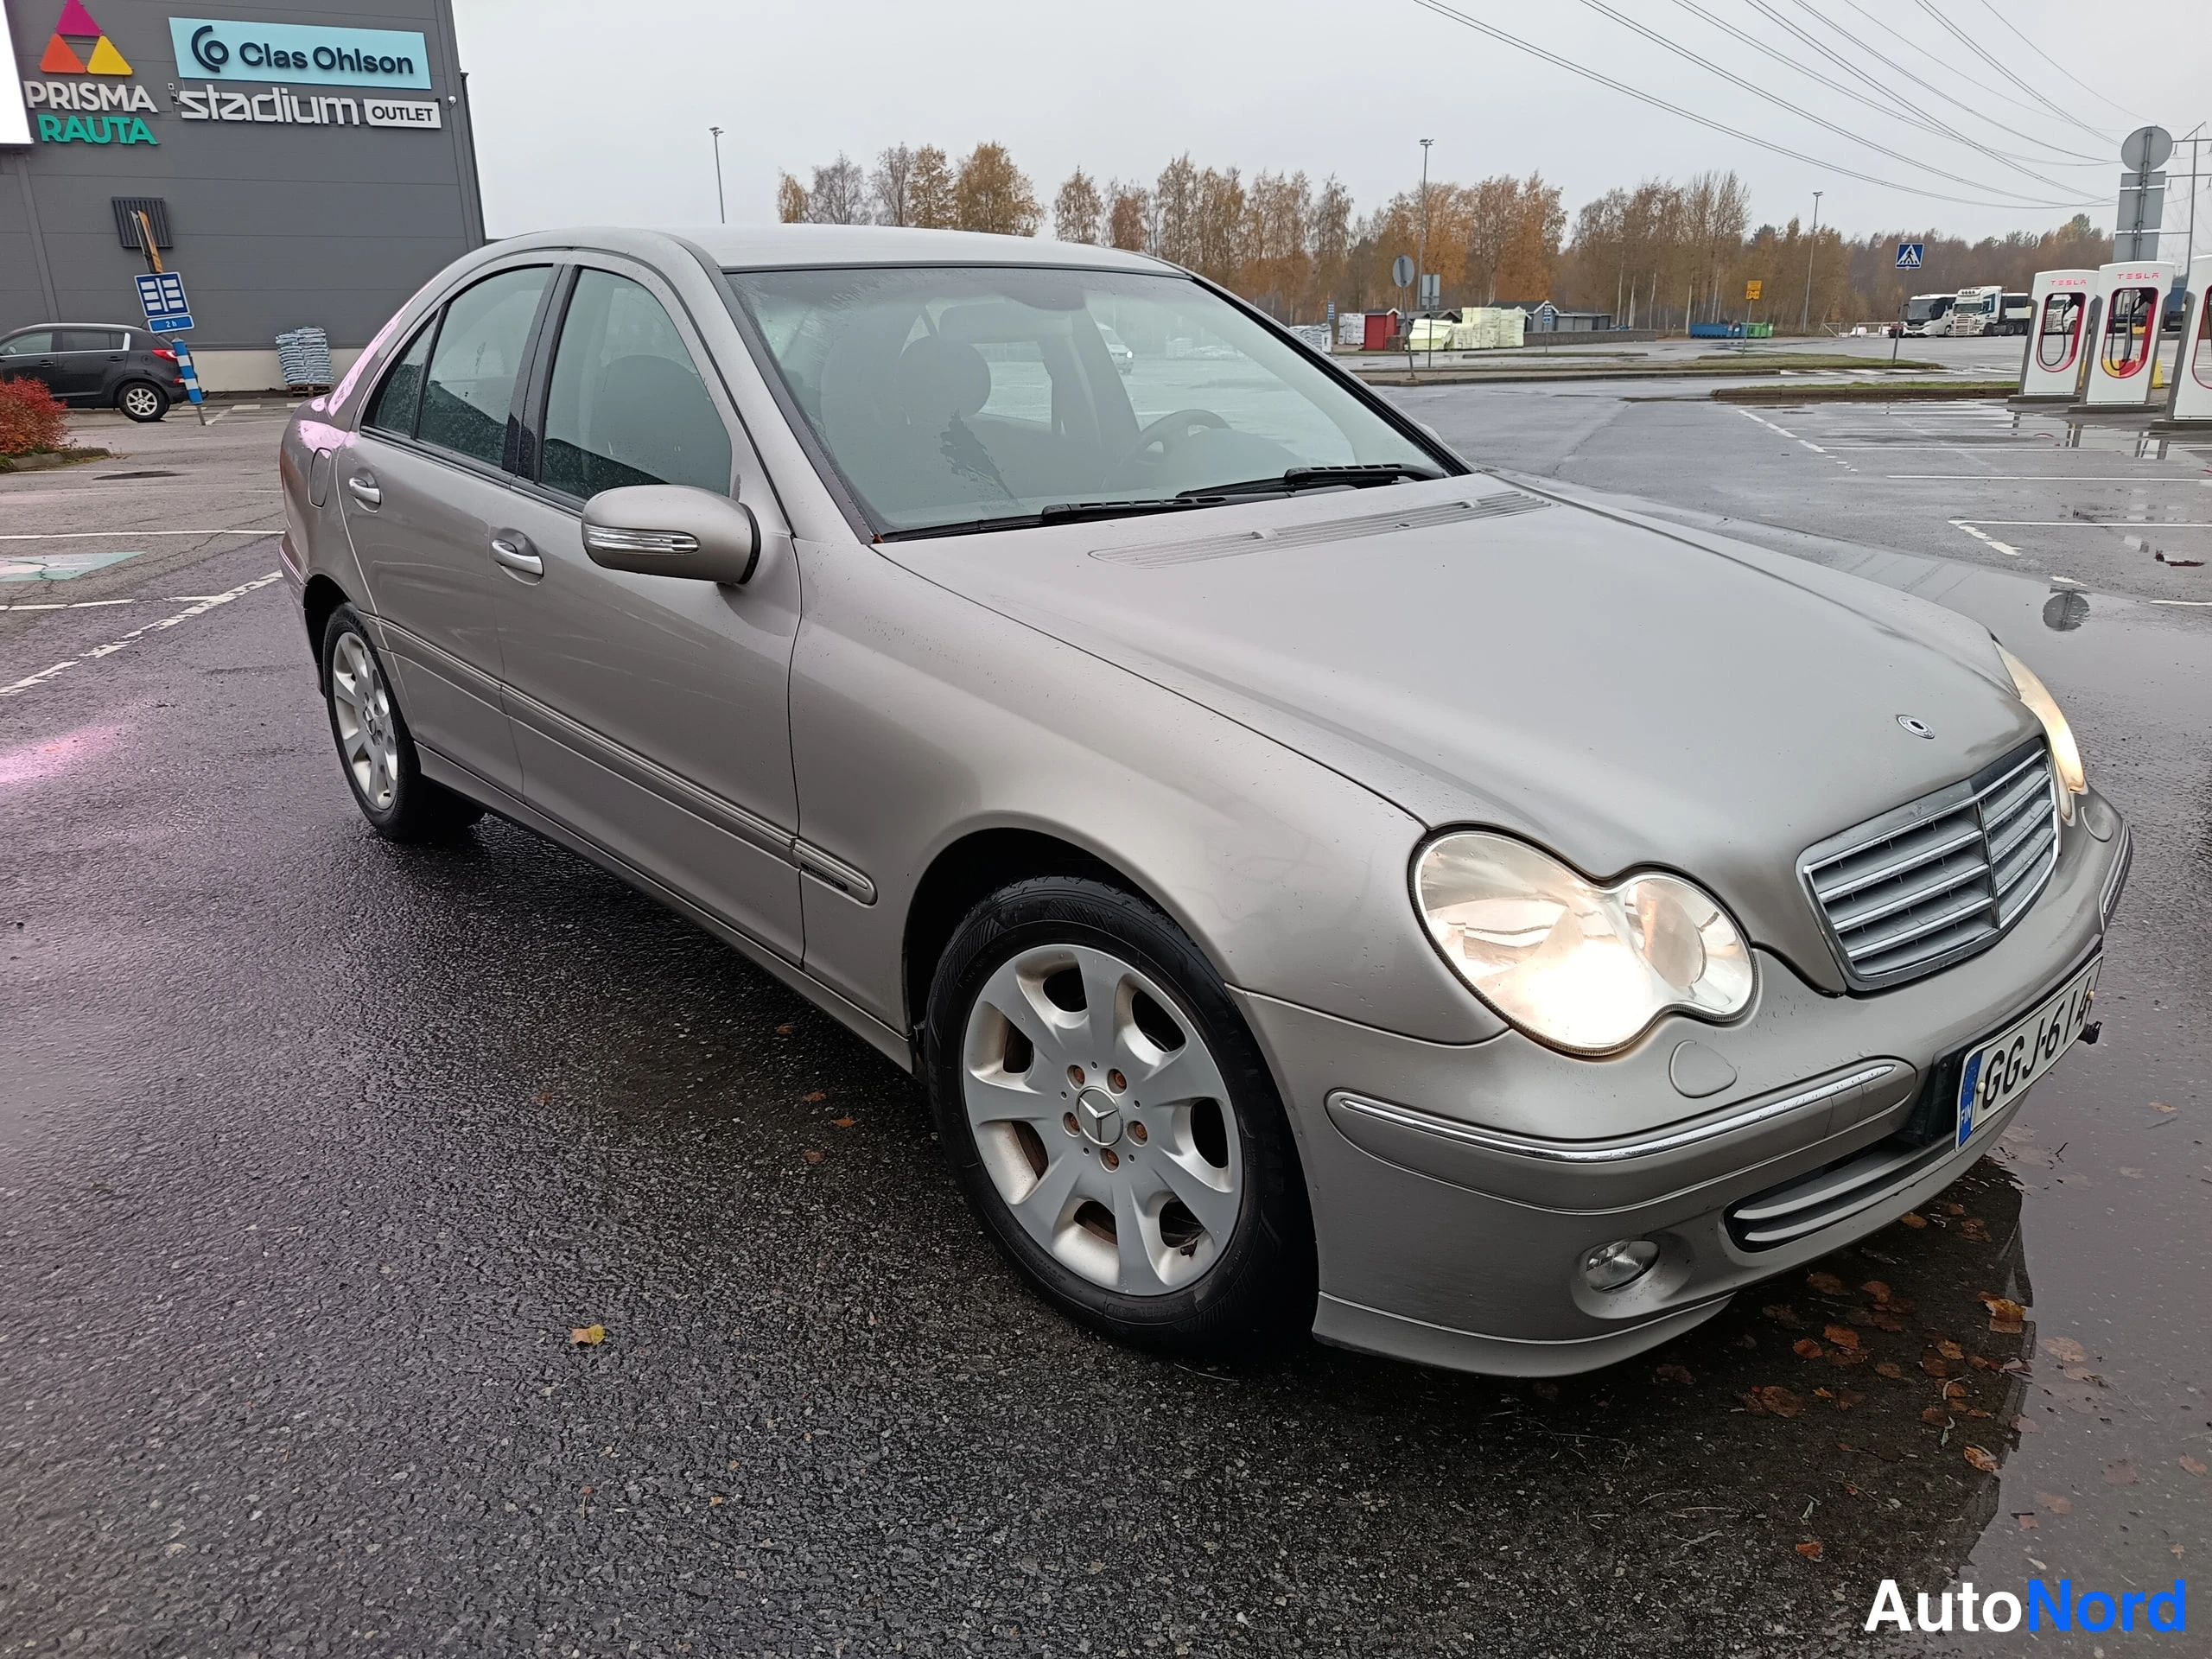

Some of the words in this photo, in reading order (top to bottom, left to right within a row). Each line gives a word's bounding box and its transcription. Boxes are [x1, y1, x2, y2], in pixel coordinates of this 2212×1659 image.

[239, 41, 308, 69] Clas
[313, 46, 414, 74] Ohlson
[23, 80, 159, 113] PRISMA
[179, 84, 360, 126] stadium
[372, 105, 434, 122] OUTLET
[37, 114, 160, 145] RAUTA
[1981, 975, 2092, 1109] GGJ-614
[1961, 1101, 1974, 1127] FIN
